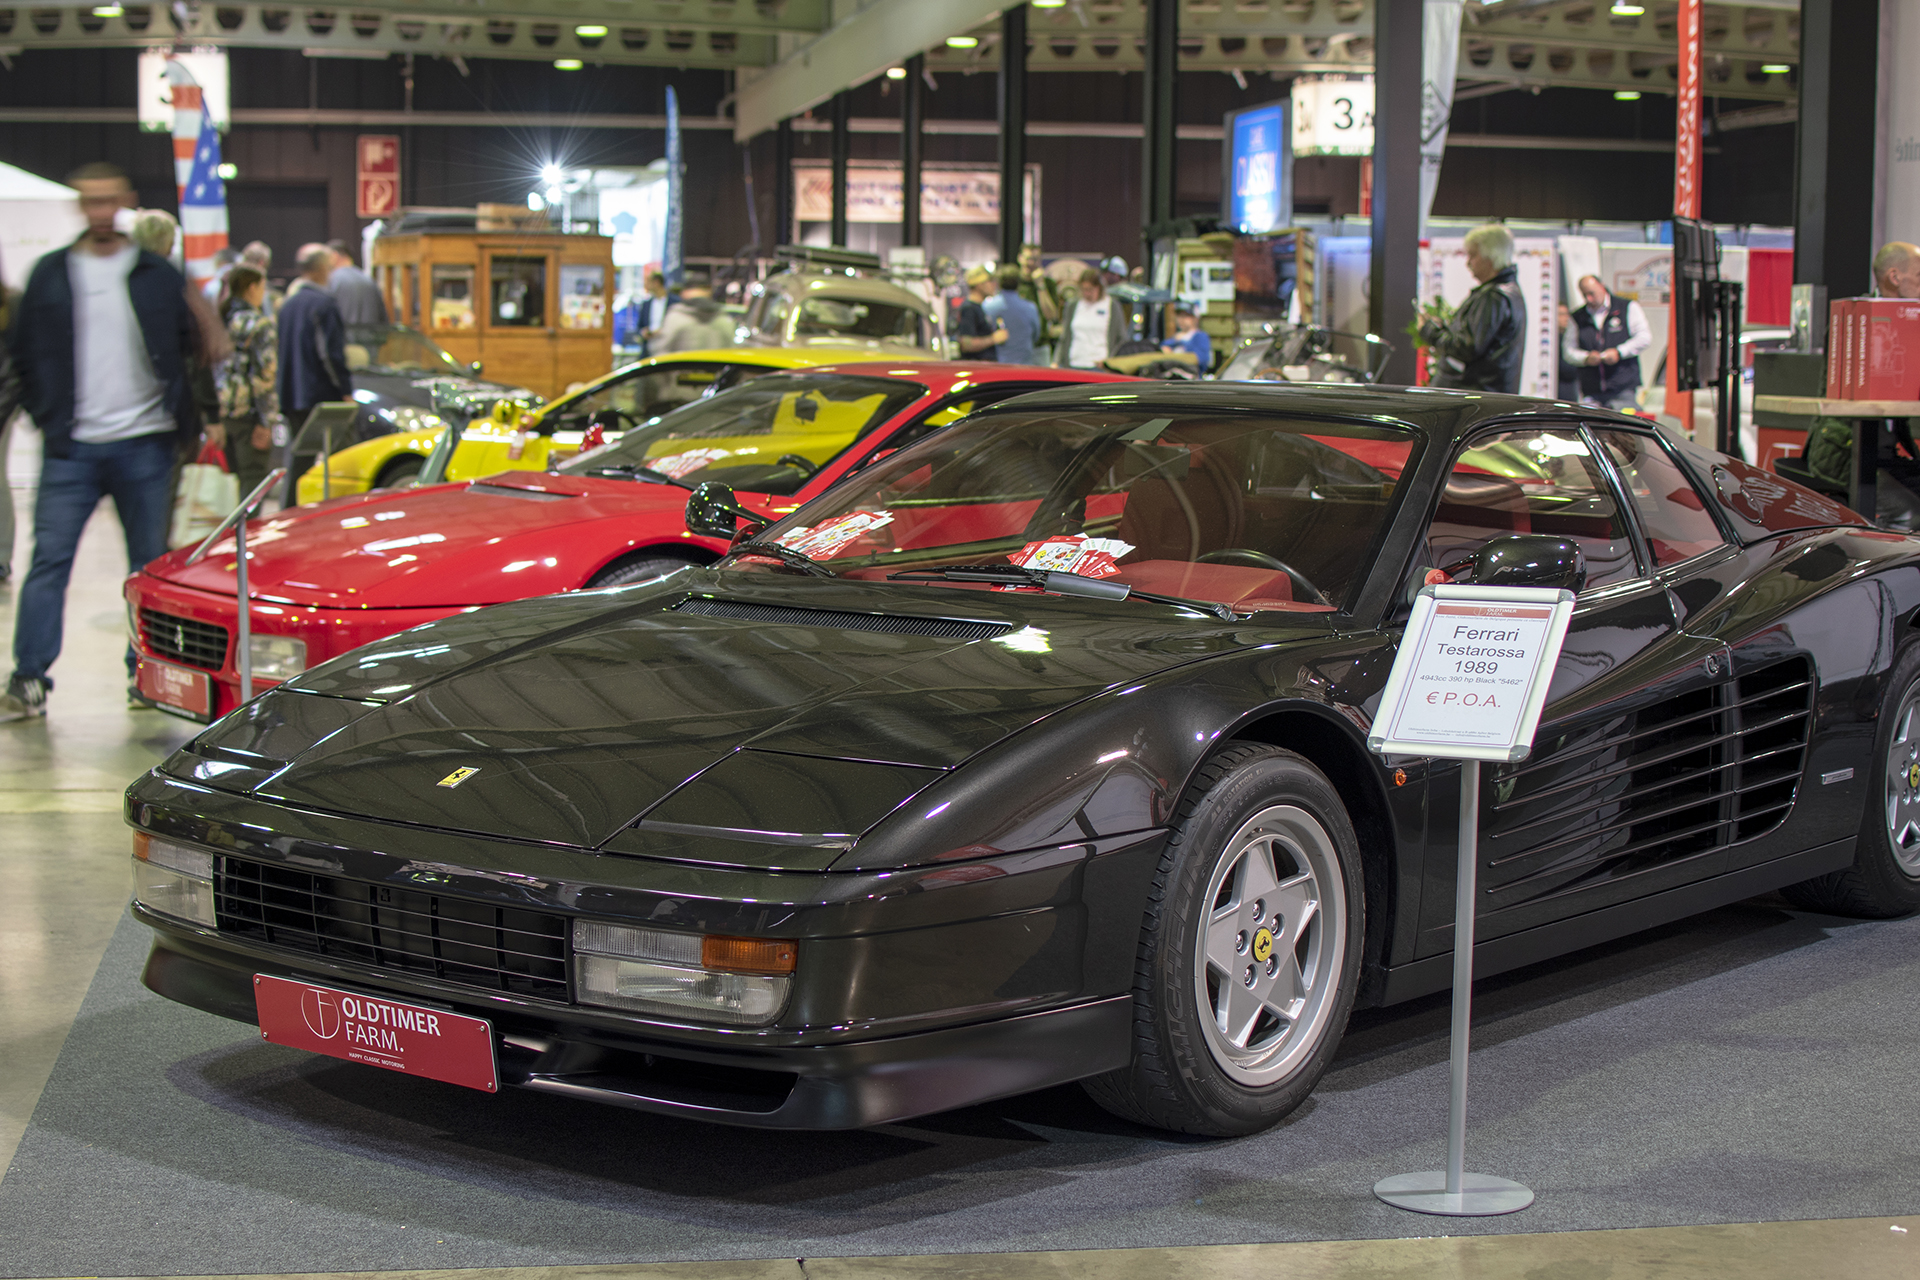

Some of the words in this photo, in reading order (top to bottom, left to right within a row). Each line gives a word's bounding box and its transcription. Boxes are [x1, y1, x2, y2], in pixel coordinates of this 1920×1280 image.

[1453, 625, 1520, 642] Ferrari
[1437, 643, 1525, 659] Testarossa
[1454, 660, 1499, 675] 1989
[1420, 674, 1447, 683] 4943cc
[1448, 676, 1463, 684] 390
[1464, 676, 1474, 684] hp
[1475, 676, 1496, 685] Black
[1498, 678, 1524, 686] "5462"
[1426, 691, 1440, 705] €
[1443, 692, 1501, 708] P.O.A.
[1223, 773, 1253, 804] ROTATION
[1166, 839, 1205, 1082] MICHELIN
[342, 996, 441, 1037] OLDTIMER
[345, 1021, 404, 1053] FARM.
[348, 1052, 363, 1060] HAPPY
[363, 1055, 381, 1064] CLASSIC
[381, 1059, 405, 1069] MOTORING
